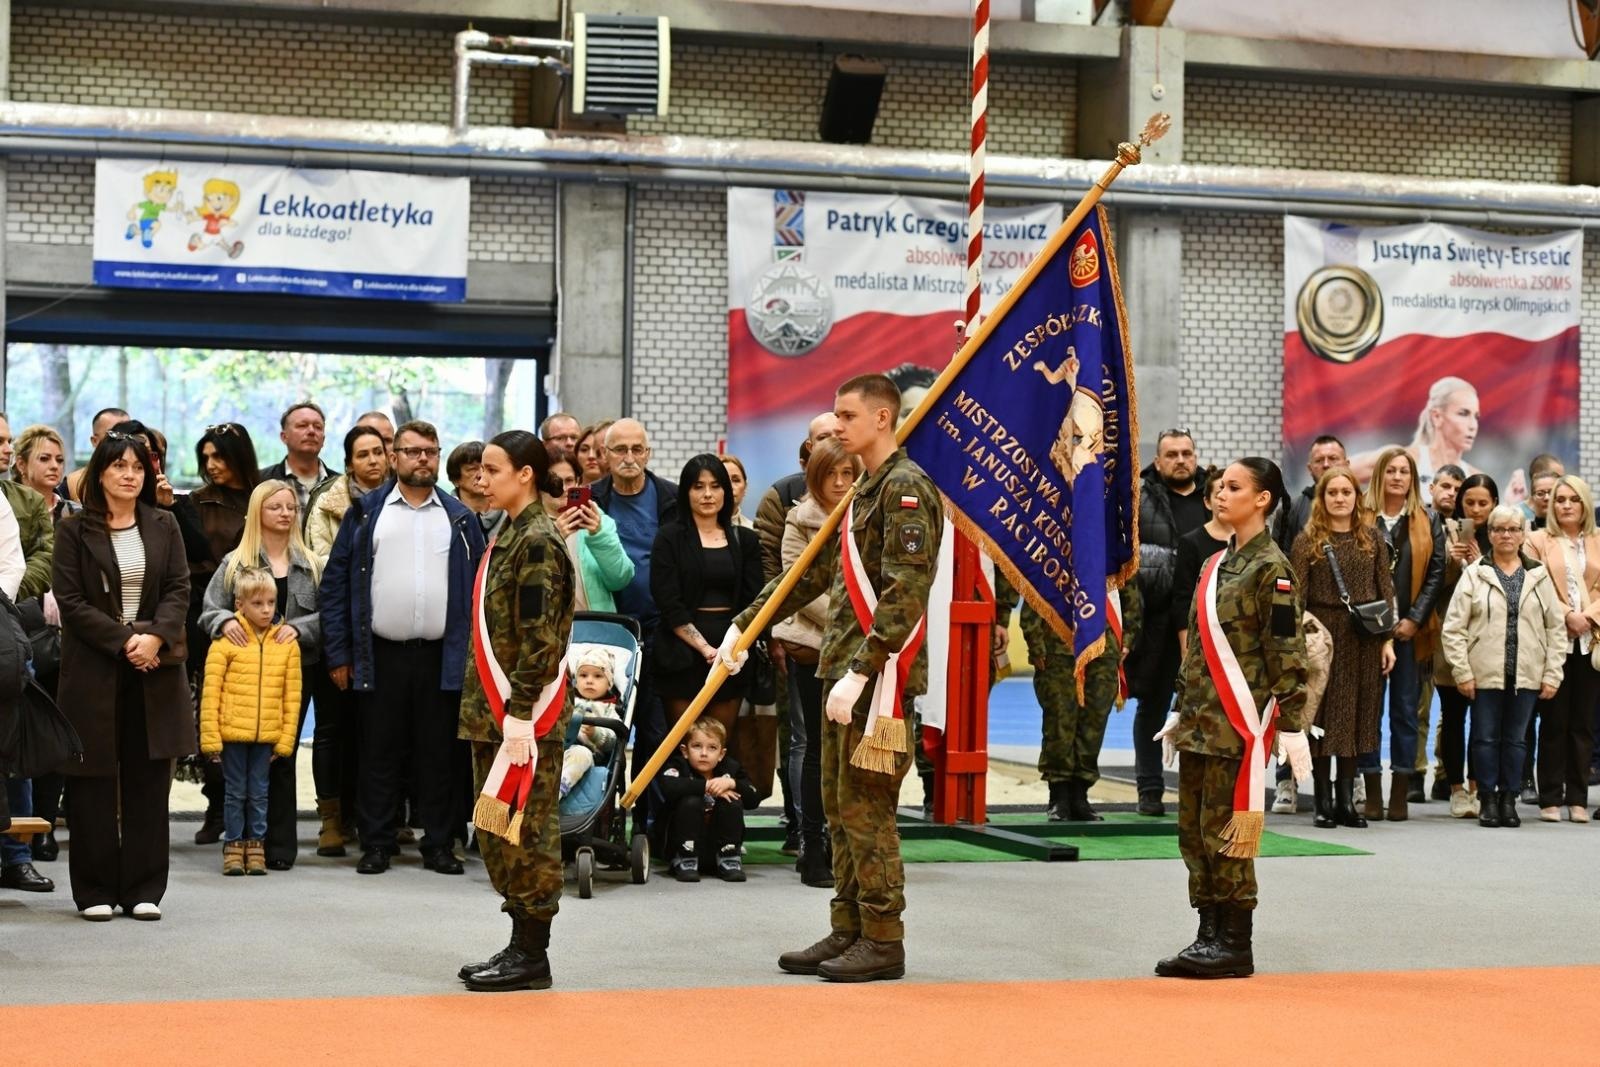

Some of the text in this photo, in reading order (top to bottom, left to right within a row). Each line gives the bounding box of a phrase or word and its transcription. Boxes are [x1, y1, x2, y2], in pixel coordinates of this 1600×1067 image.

[258, 193, 433, 228] Lekkoatletyka
[258, 223, 352, 243] dla każdego!
[827, 209, 1047, 243] Patryk Grzegozewicz
[988, 250, 1038, 269] ZSOM
[1373, 239, 1571, 269] Justyna Święty-Ersetic
[835, 272, 908, 292] medalista
[1450, 272, 1572, 290] absolwentka ZSOMS
[1392, 293, 1571, 316] medalistka Igrzysk Olimpijskich
[953, 390, 1061, 508] MISTRZOSTWA
[936, 411, 962, 443] im.
[963, 436, 1033, 513] JANUSZA
[961, 466, 985, 491] W
